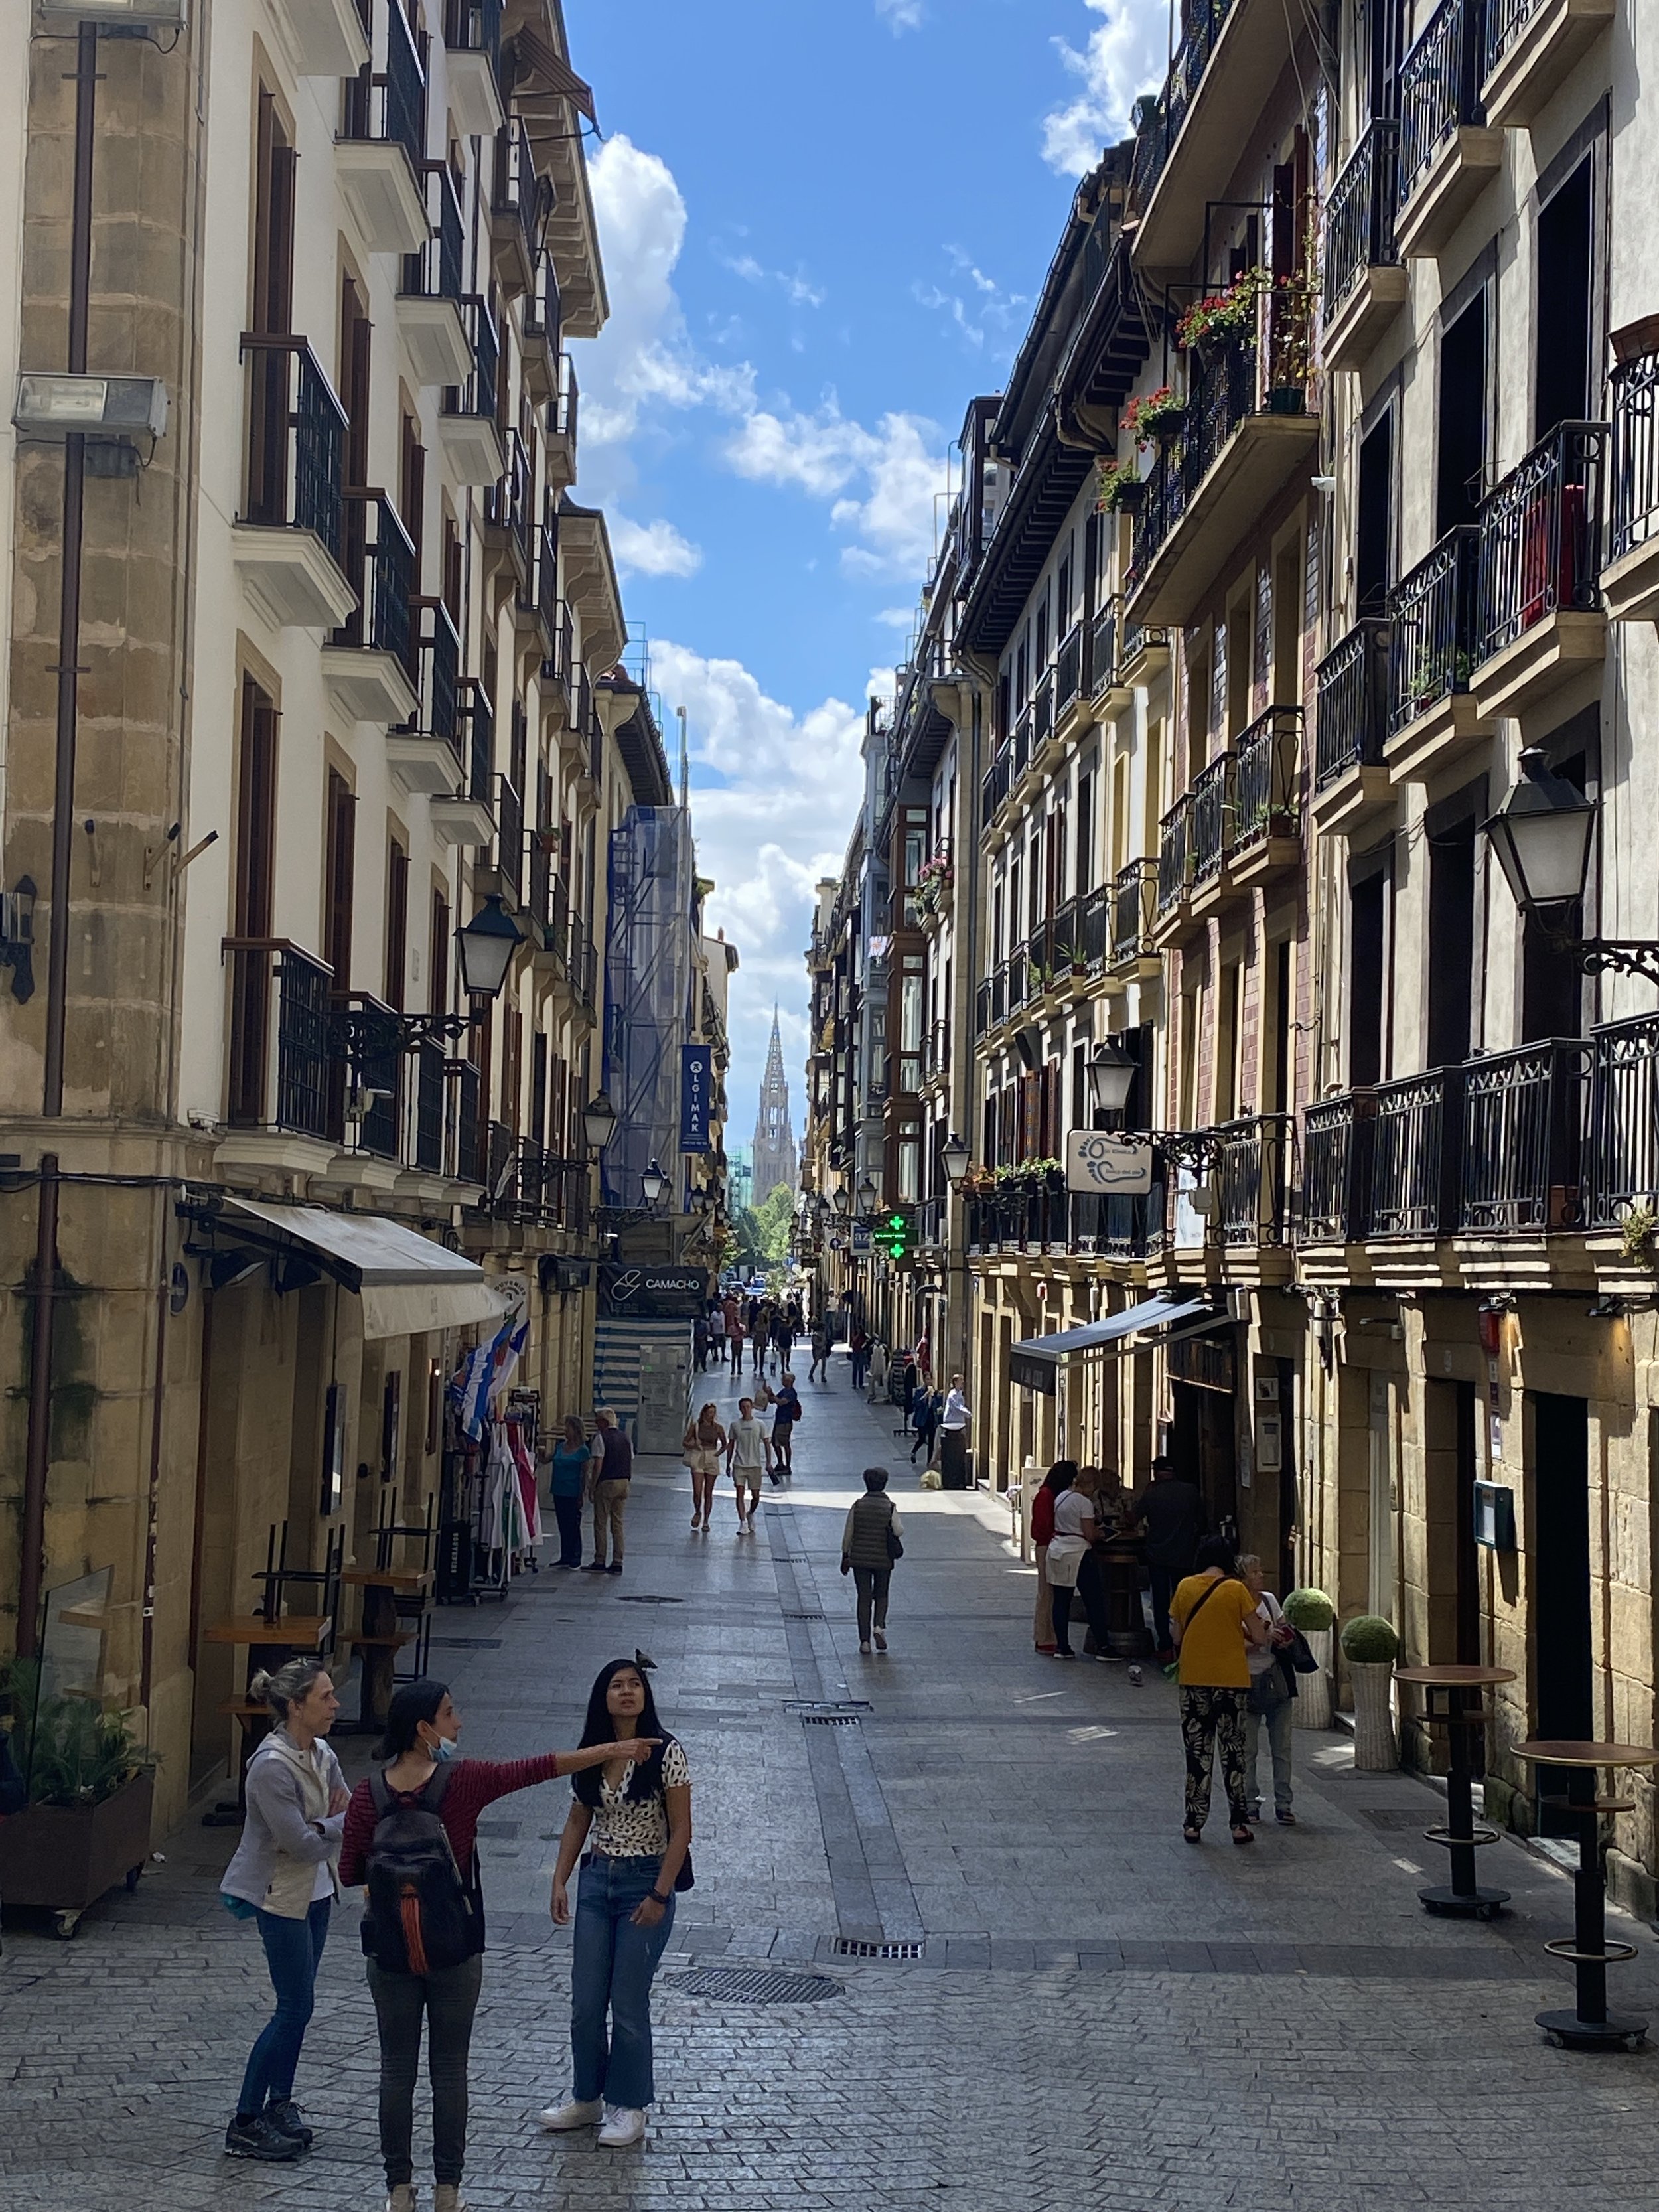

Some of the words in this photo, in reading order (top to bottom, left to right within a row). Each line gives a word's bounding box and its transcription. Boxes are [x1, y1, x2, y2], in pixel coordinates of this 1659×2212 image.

[690, 1061, 703, 1132] ALGIMAK
[494, 1280, 526, 1296] OUVENIRS
[646, 1278, 699, 1290] CAMACHO
